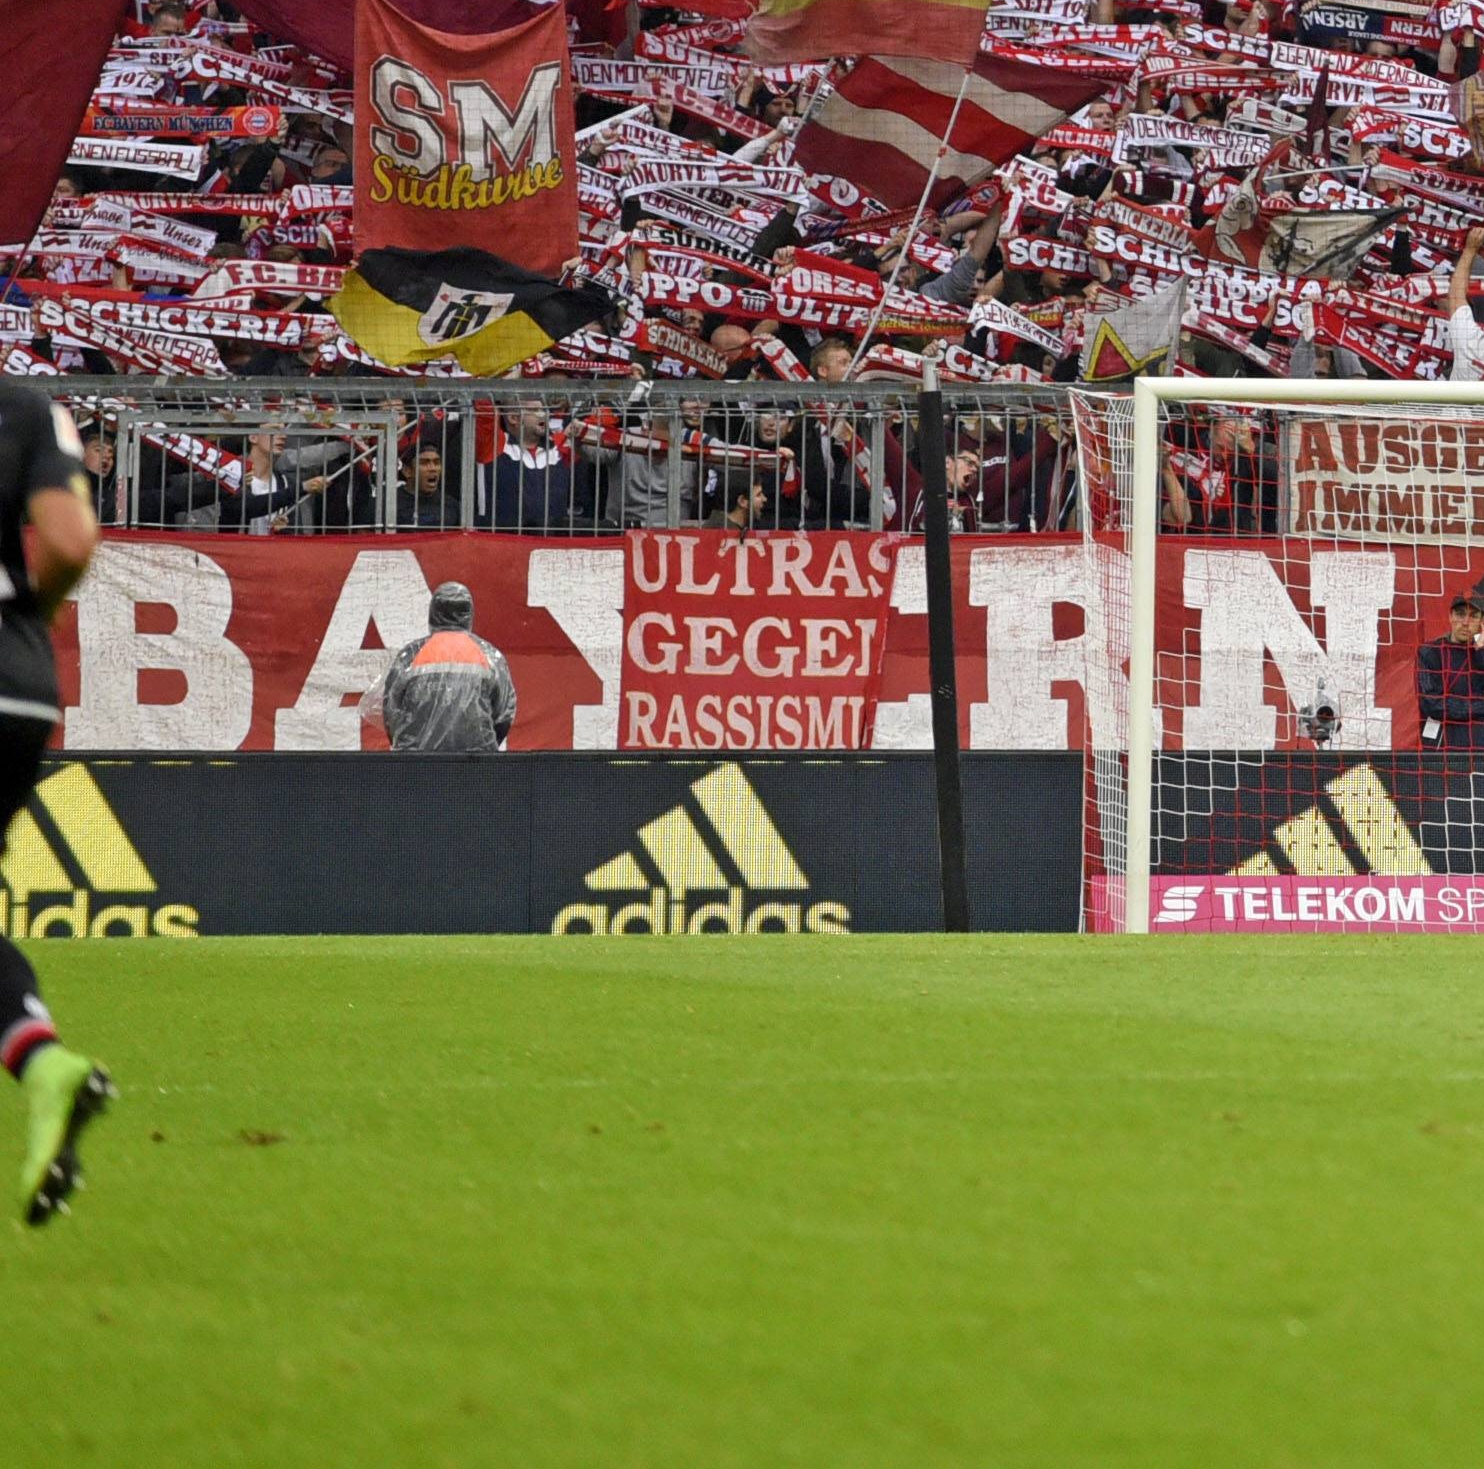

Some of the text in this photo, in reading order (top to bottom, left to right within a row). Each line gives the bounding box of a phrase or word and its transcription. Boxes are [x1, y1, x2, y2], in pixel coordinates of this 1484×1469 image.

[169, 112, 234, 131] MÜNCHEN
[370, 53, 562, 183] SM
[370, 155, 563, 211] Südkurve
[551, 886, 852, 937] adidas
[1215, 887, 1425, 923] TELEKOM
